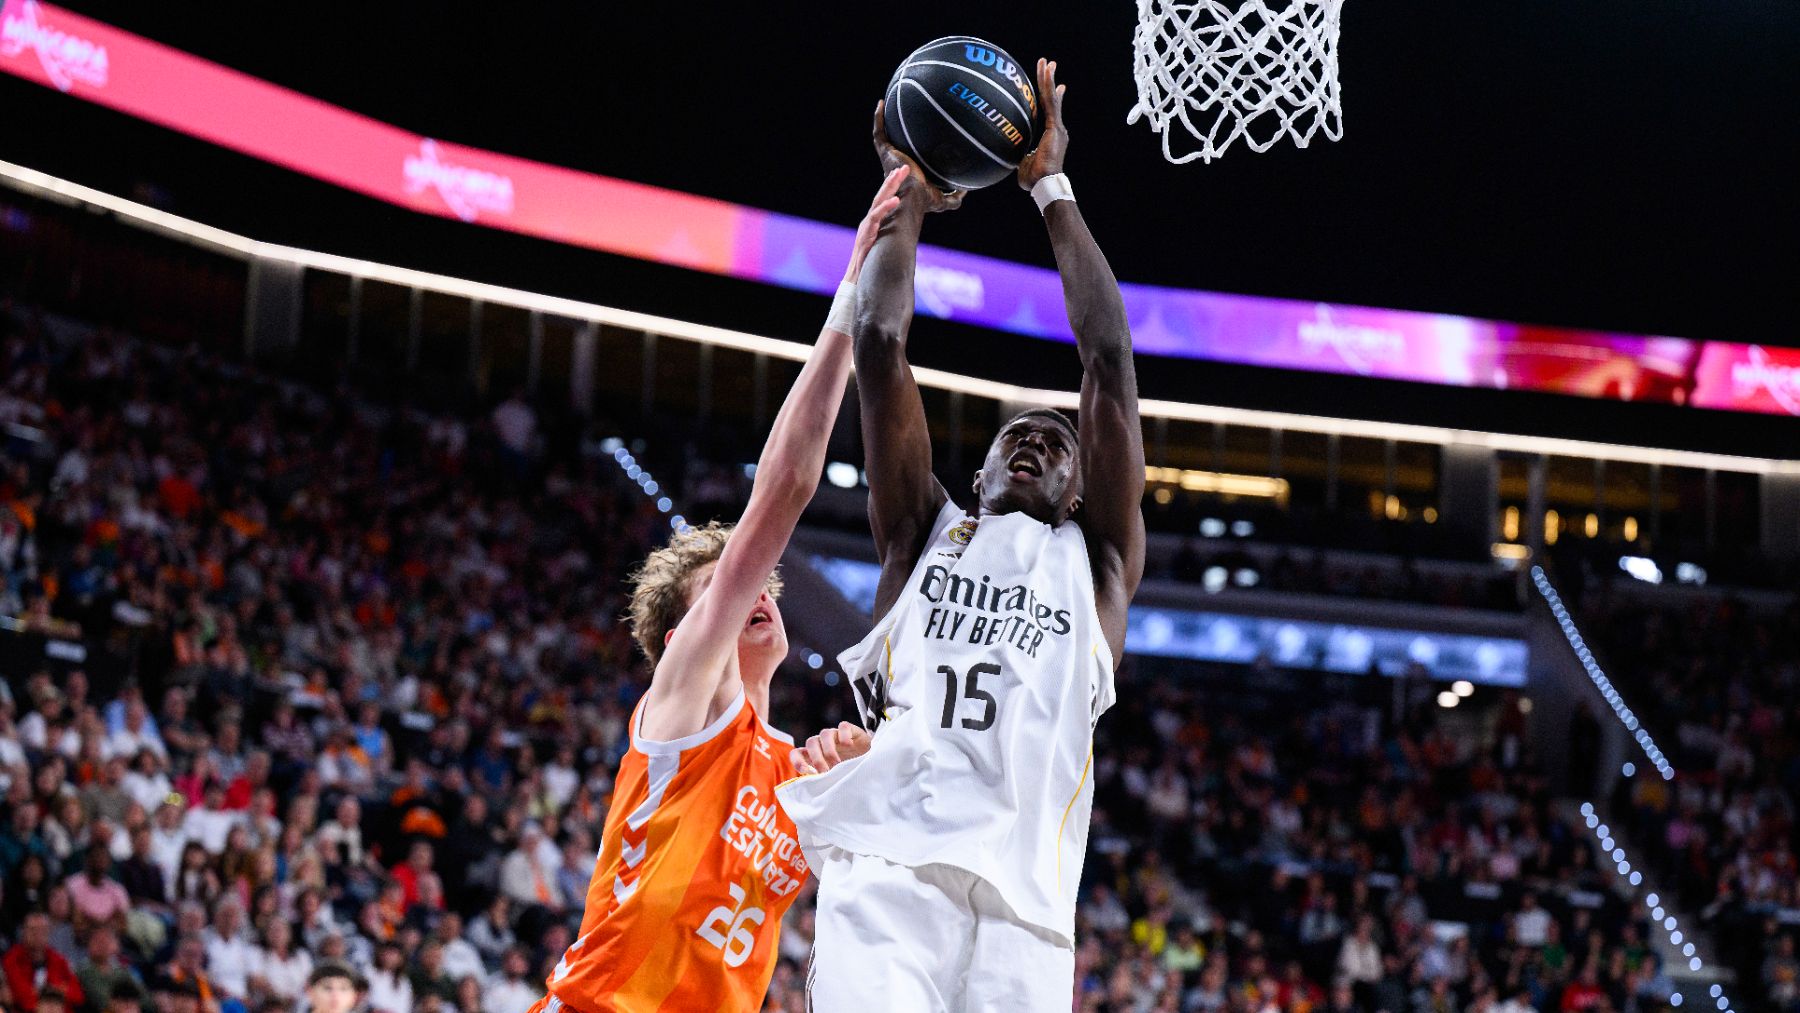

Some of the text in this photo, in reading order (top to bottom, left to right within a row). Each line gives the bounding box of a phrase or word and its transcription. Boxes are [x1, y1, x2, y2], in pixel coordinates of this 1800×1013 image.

[948, 81, 1024, 146] EVOLUTION
[919, 564, 1071, 636] Emirates
[924, 608, 1044, 659] FLY BETTER
[937, 662, 1002, 732] 15
[735, 784, 798, 862] Cultura
[696, 882, 766, 968] 26
